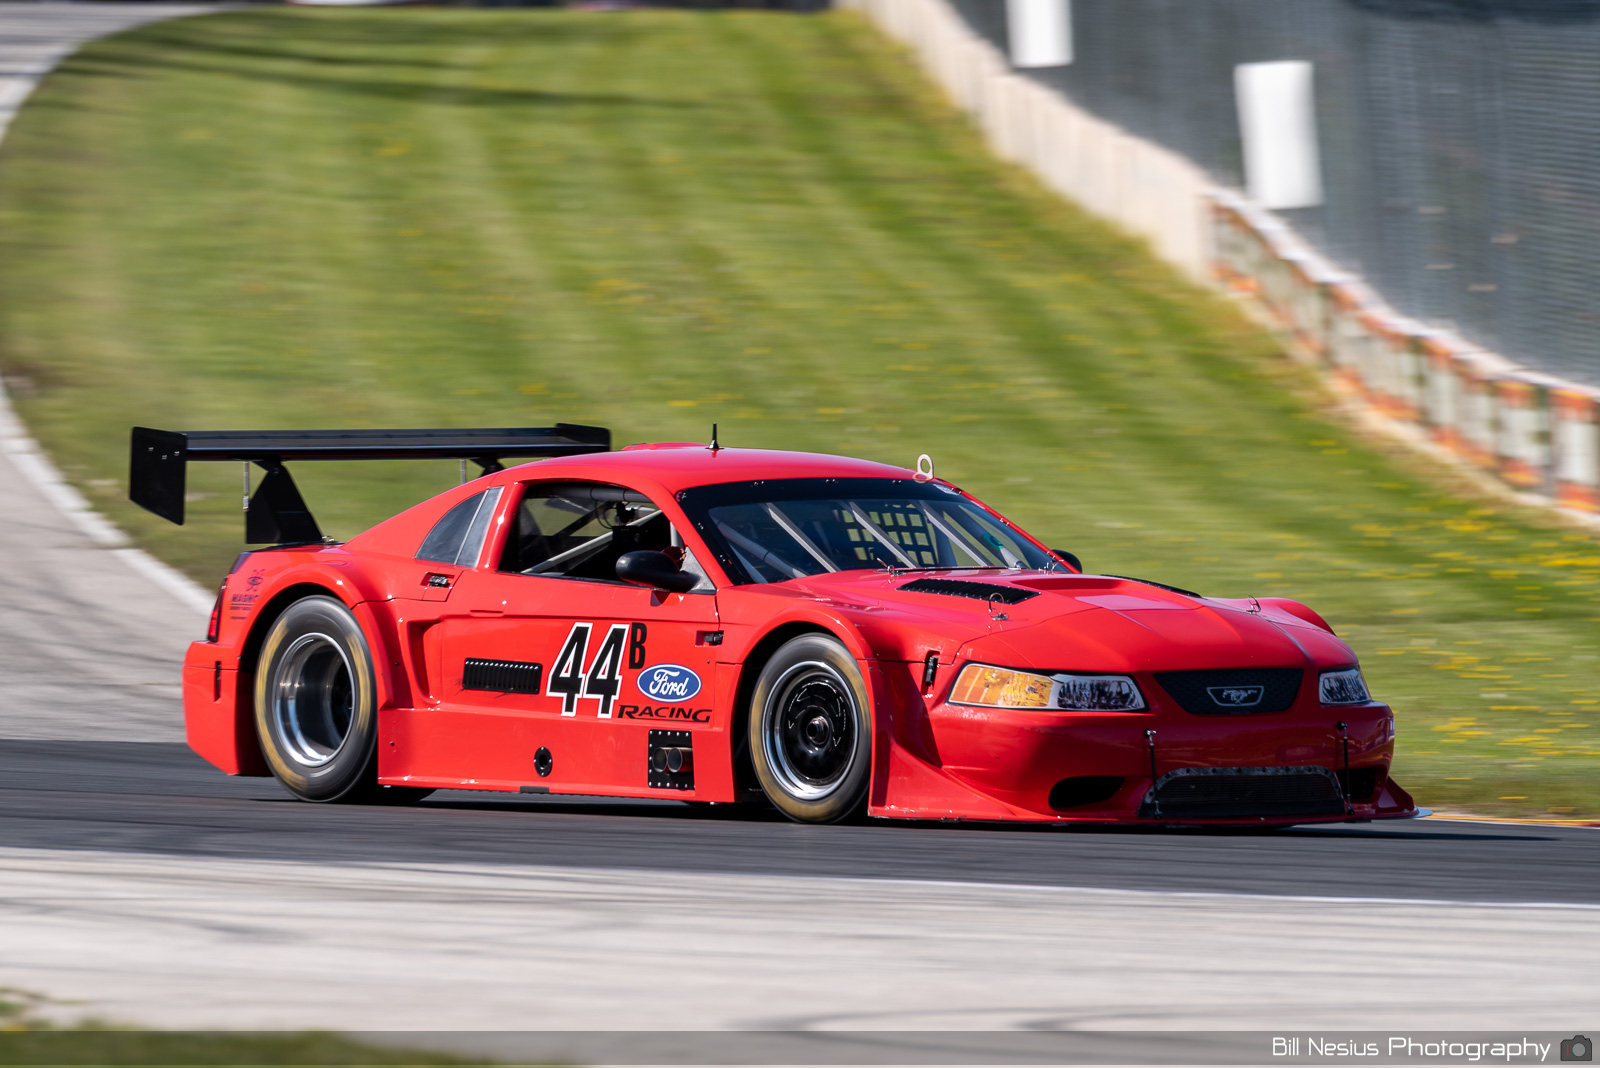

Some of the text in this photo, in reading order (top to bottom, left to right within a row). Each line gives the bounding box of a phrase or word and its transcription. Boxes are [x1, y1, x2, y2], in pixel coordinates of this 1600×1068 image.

[546, 622, 648, 719] 44 B
[649, 668, 690, 697] Ford
[617, 704, 713, 723] RACING
